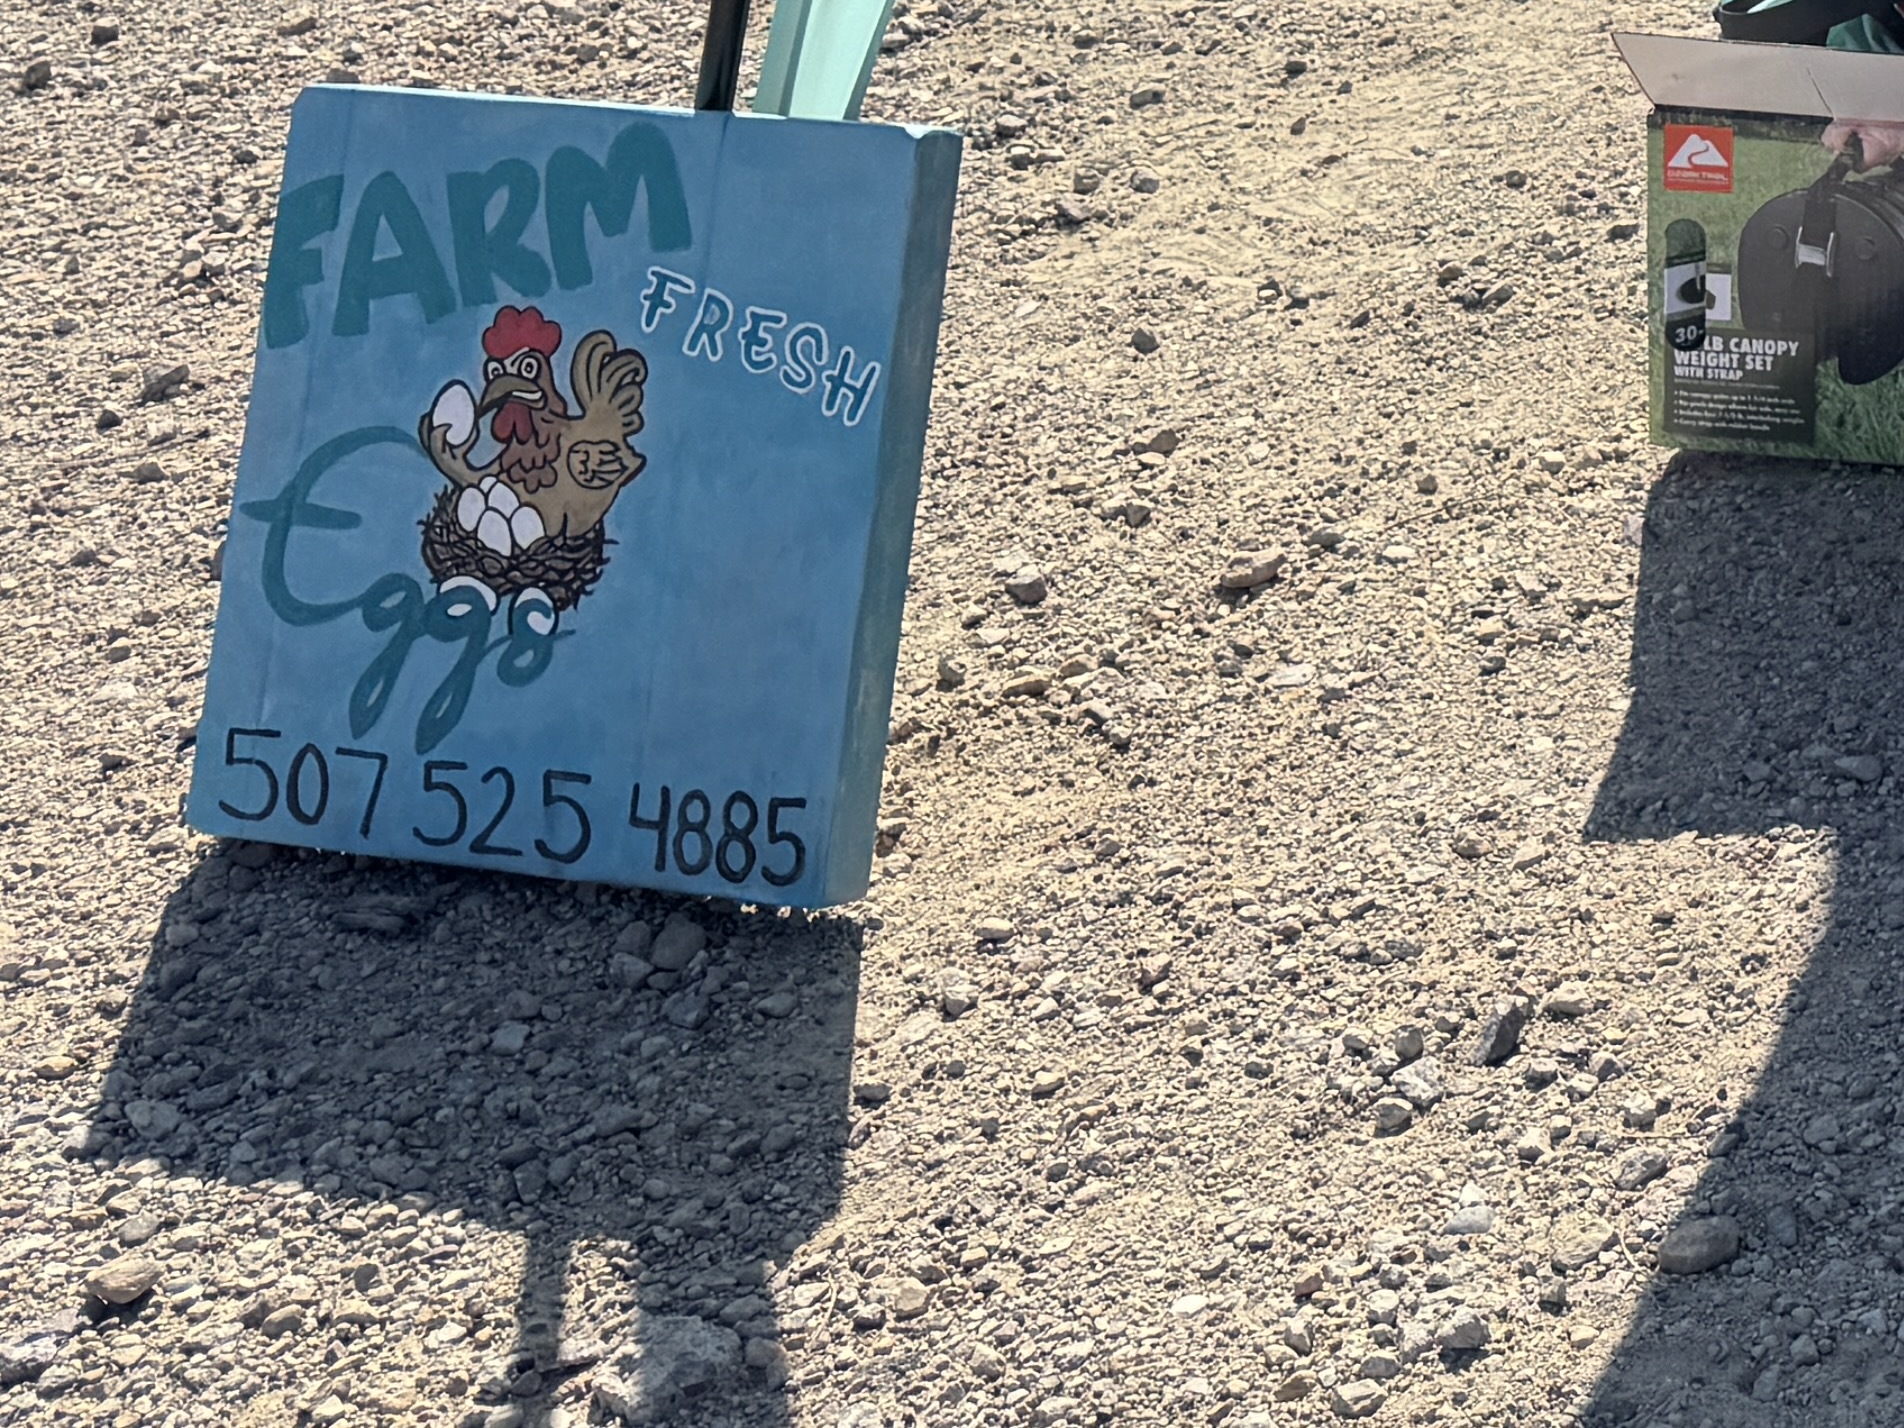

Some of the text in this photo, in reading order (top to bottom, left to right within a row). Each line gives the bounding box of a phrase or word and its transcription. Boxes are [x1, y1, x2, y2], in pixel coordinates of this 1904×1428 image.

[261, 119, 694, 349] FARM
[637, 265, 882, 427] FRESH
[1674, 349, 1774, 371] WEIGHT SET
[1674, 366, 1743, 381] WITH STRAP
[1729, 337, 1799, 356] CANOPY
[240, 425, 576, 753] Eggs
[219, 727, 809, 887] 507 525 4885
